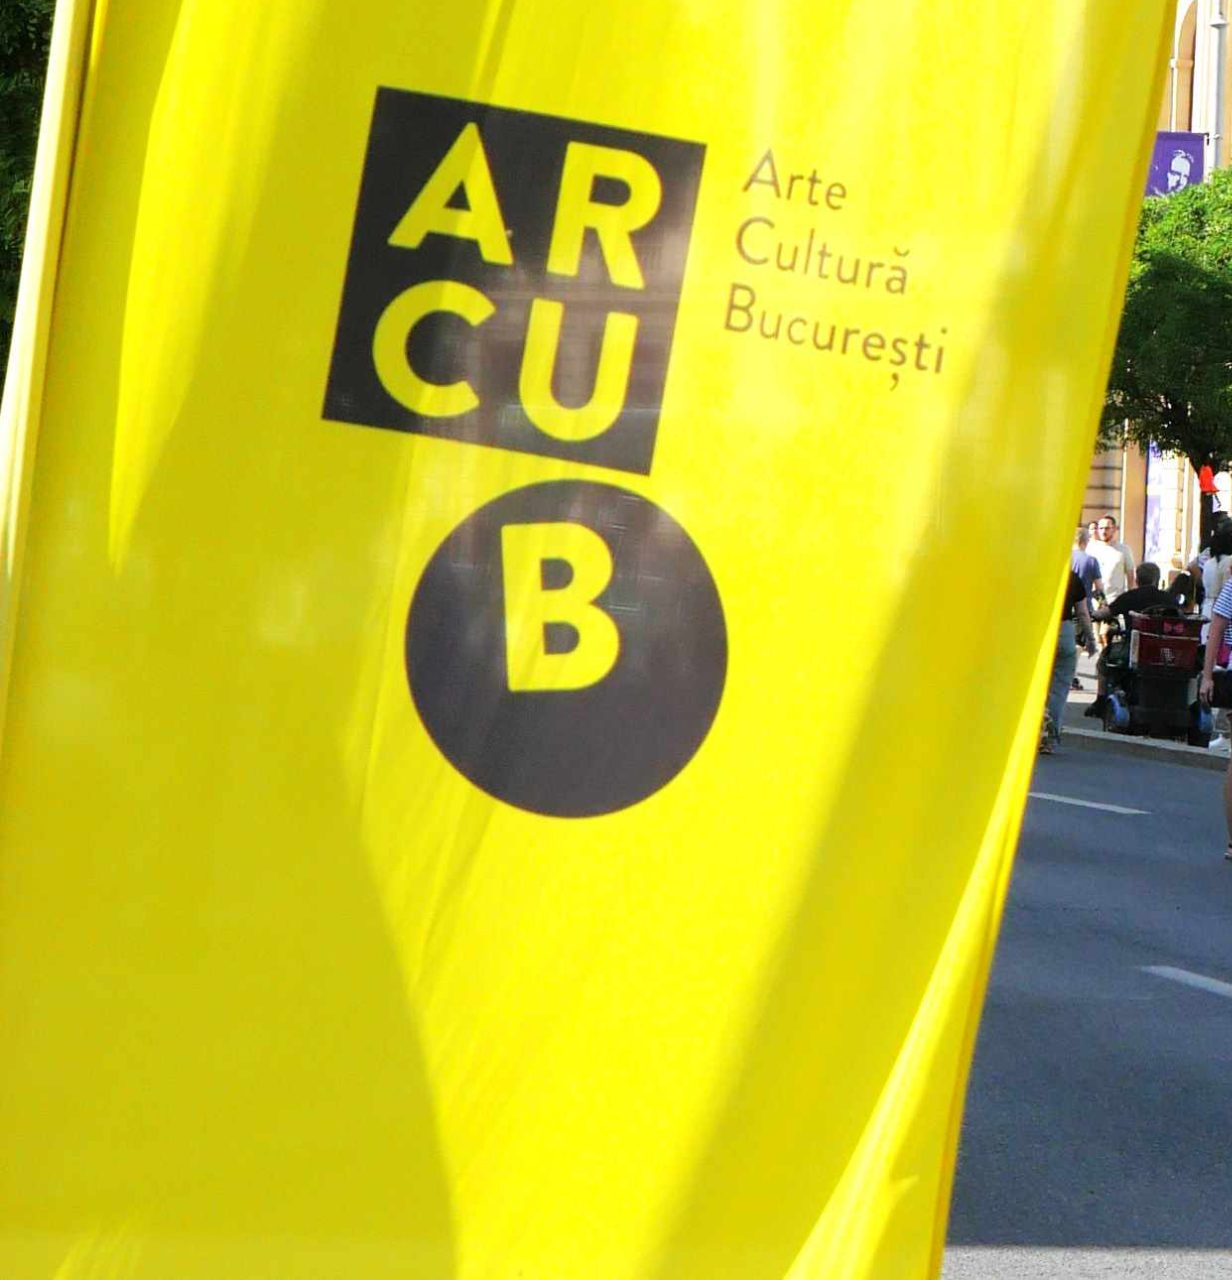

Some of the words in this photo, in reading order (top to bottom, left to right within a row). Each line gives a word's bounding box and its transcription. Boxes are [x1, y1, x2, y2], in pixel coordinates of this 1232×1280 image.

[742, 148, 849, 212] Arte
[734, 215, 911, 296] Cultură
[722, 282, 949, 392] București
